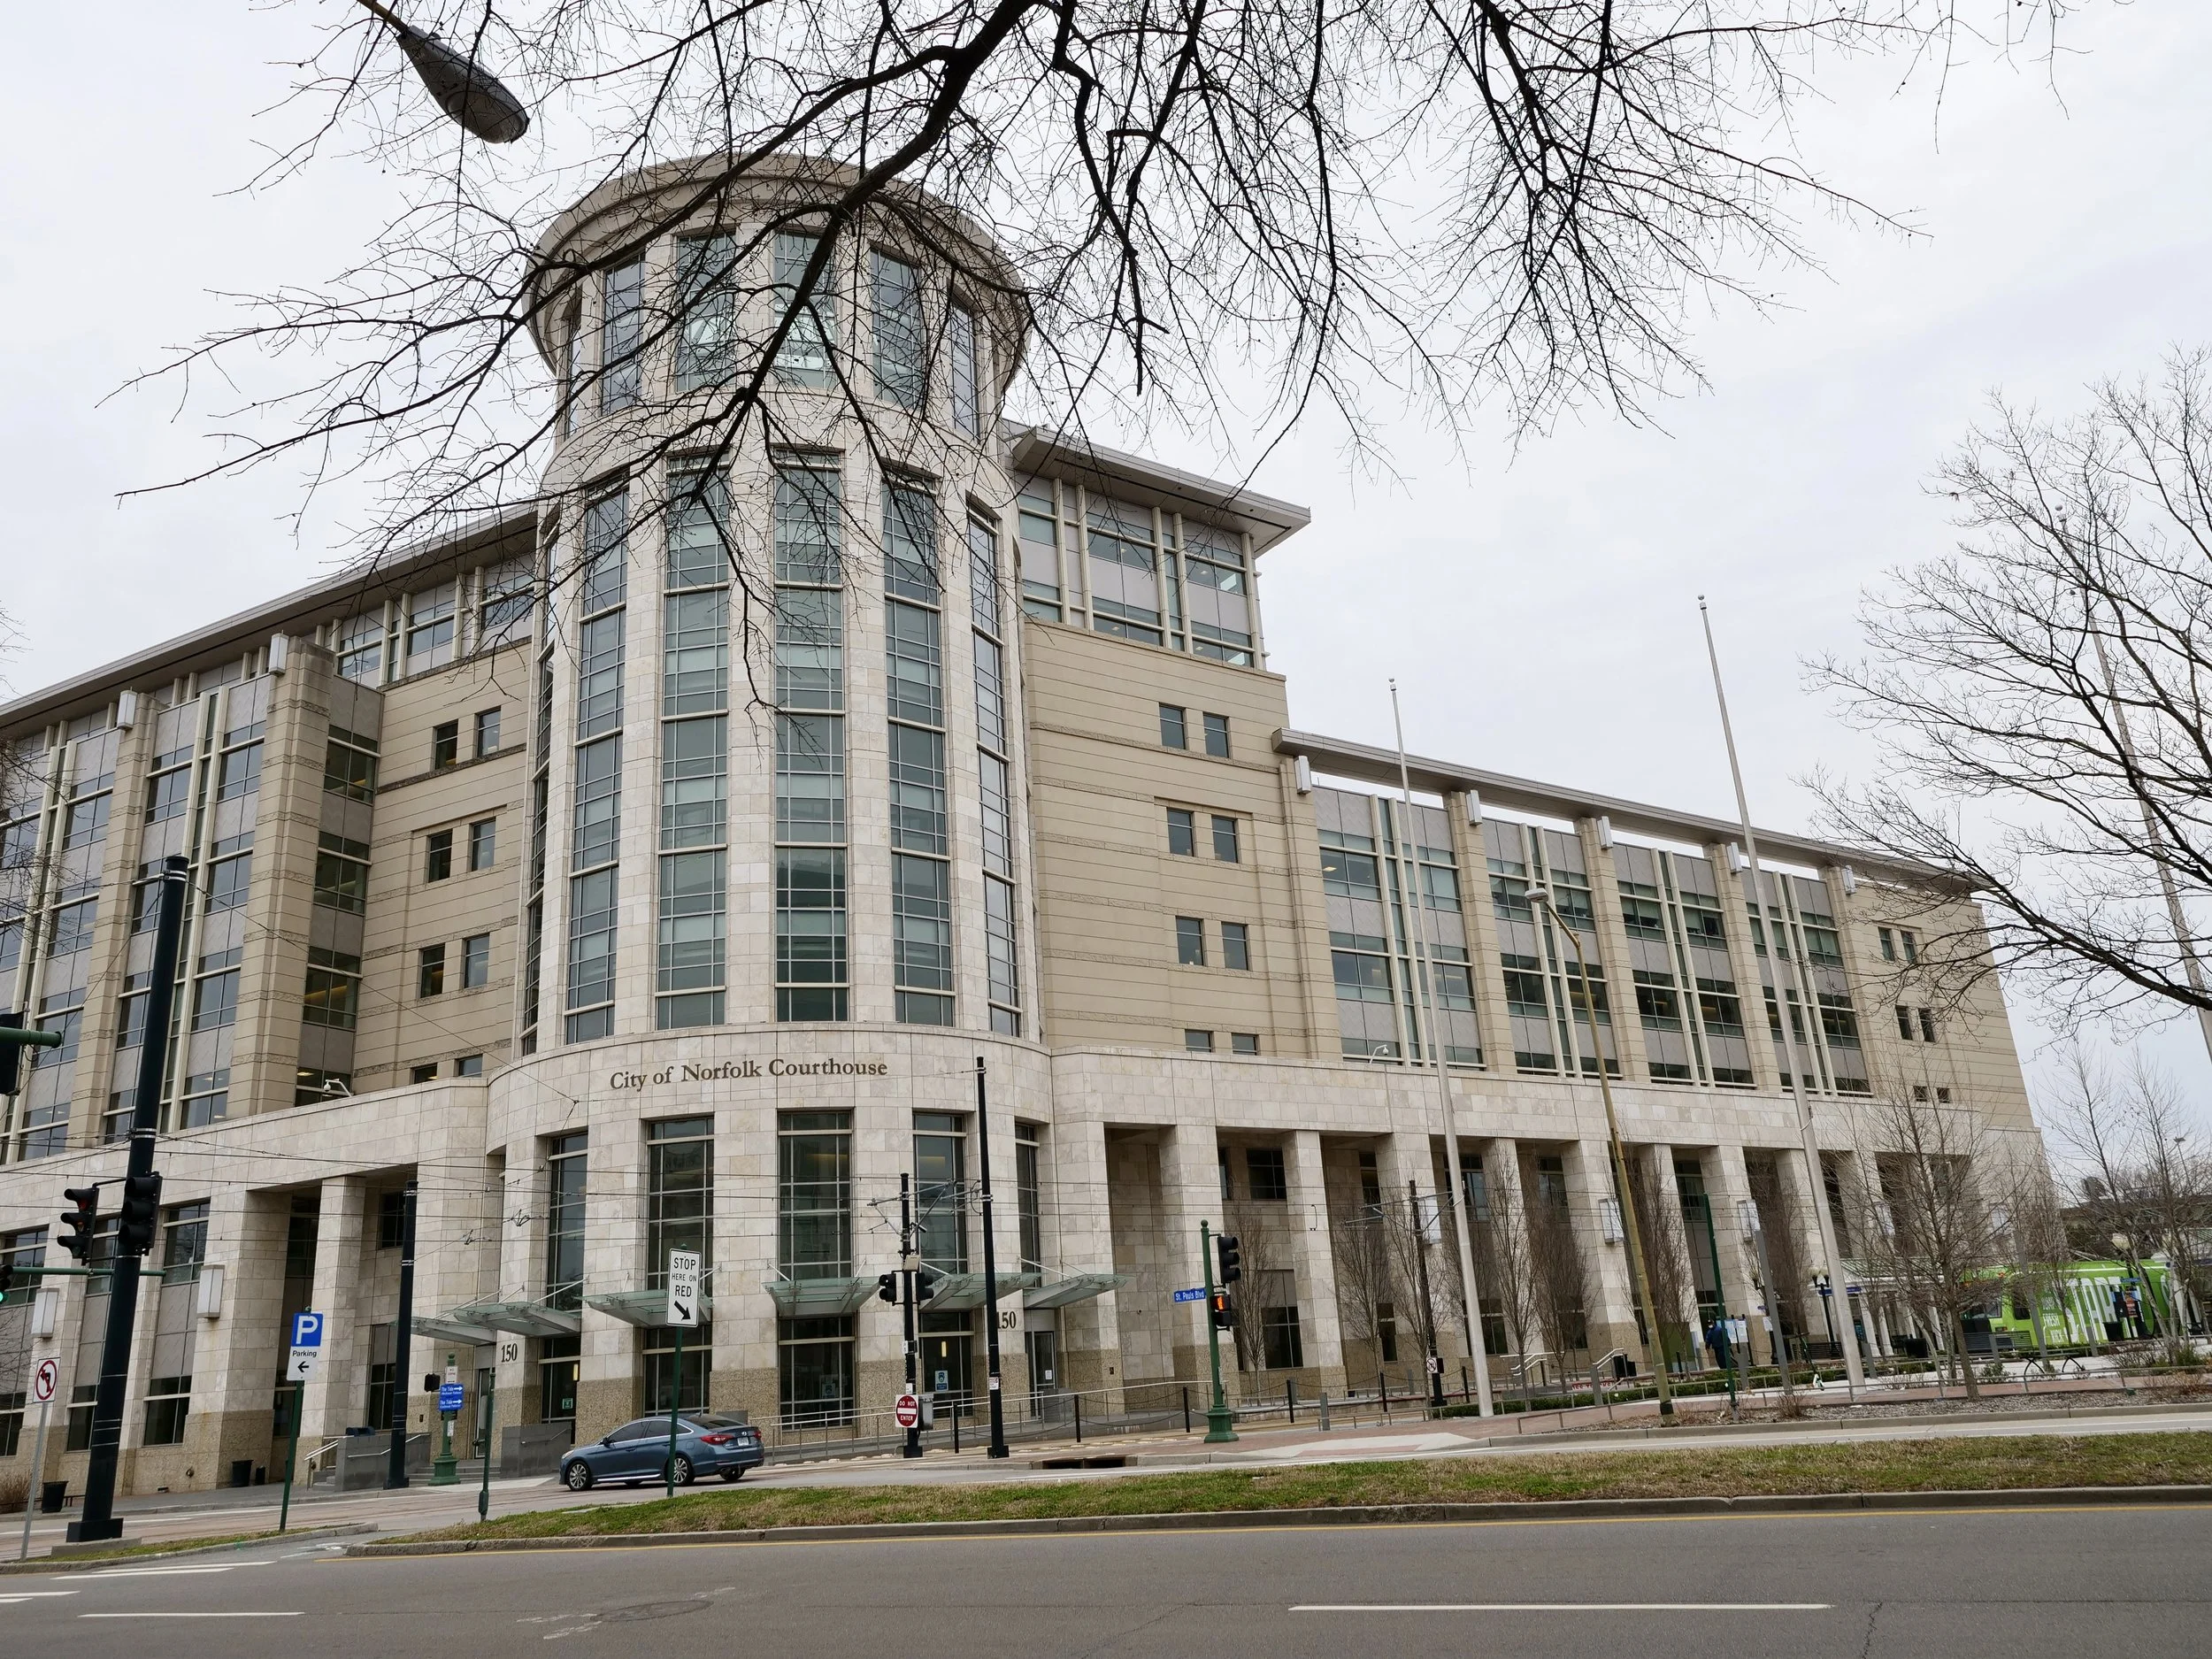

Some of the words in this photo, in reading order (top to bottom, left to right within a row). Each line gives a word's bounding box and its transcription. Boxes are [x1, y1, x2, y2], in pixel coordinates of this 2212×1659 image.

[610, 1071, 647, 1092] City
[652, 1066, 674, 1085] of
[680, 1060, 763, 1082] Norfolk
[768, 1058, 887, 1077] Courthouse
[673, 1257, 696, 1270] STOP
[672, 1272, 686, 1281] HERE
[675, 1285, 692, 1297] RED
[296, 1315, 319, 1345] P
[292, 1349, 317, 1358] Parking
[501, 1343, 518, 1363] 150
